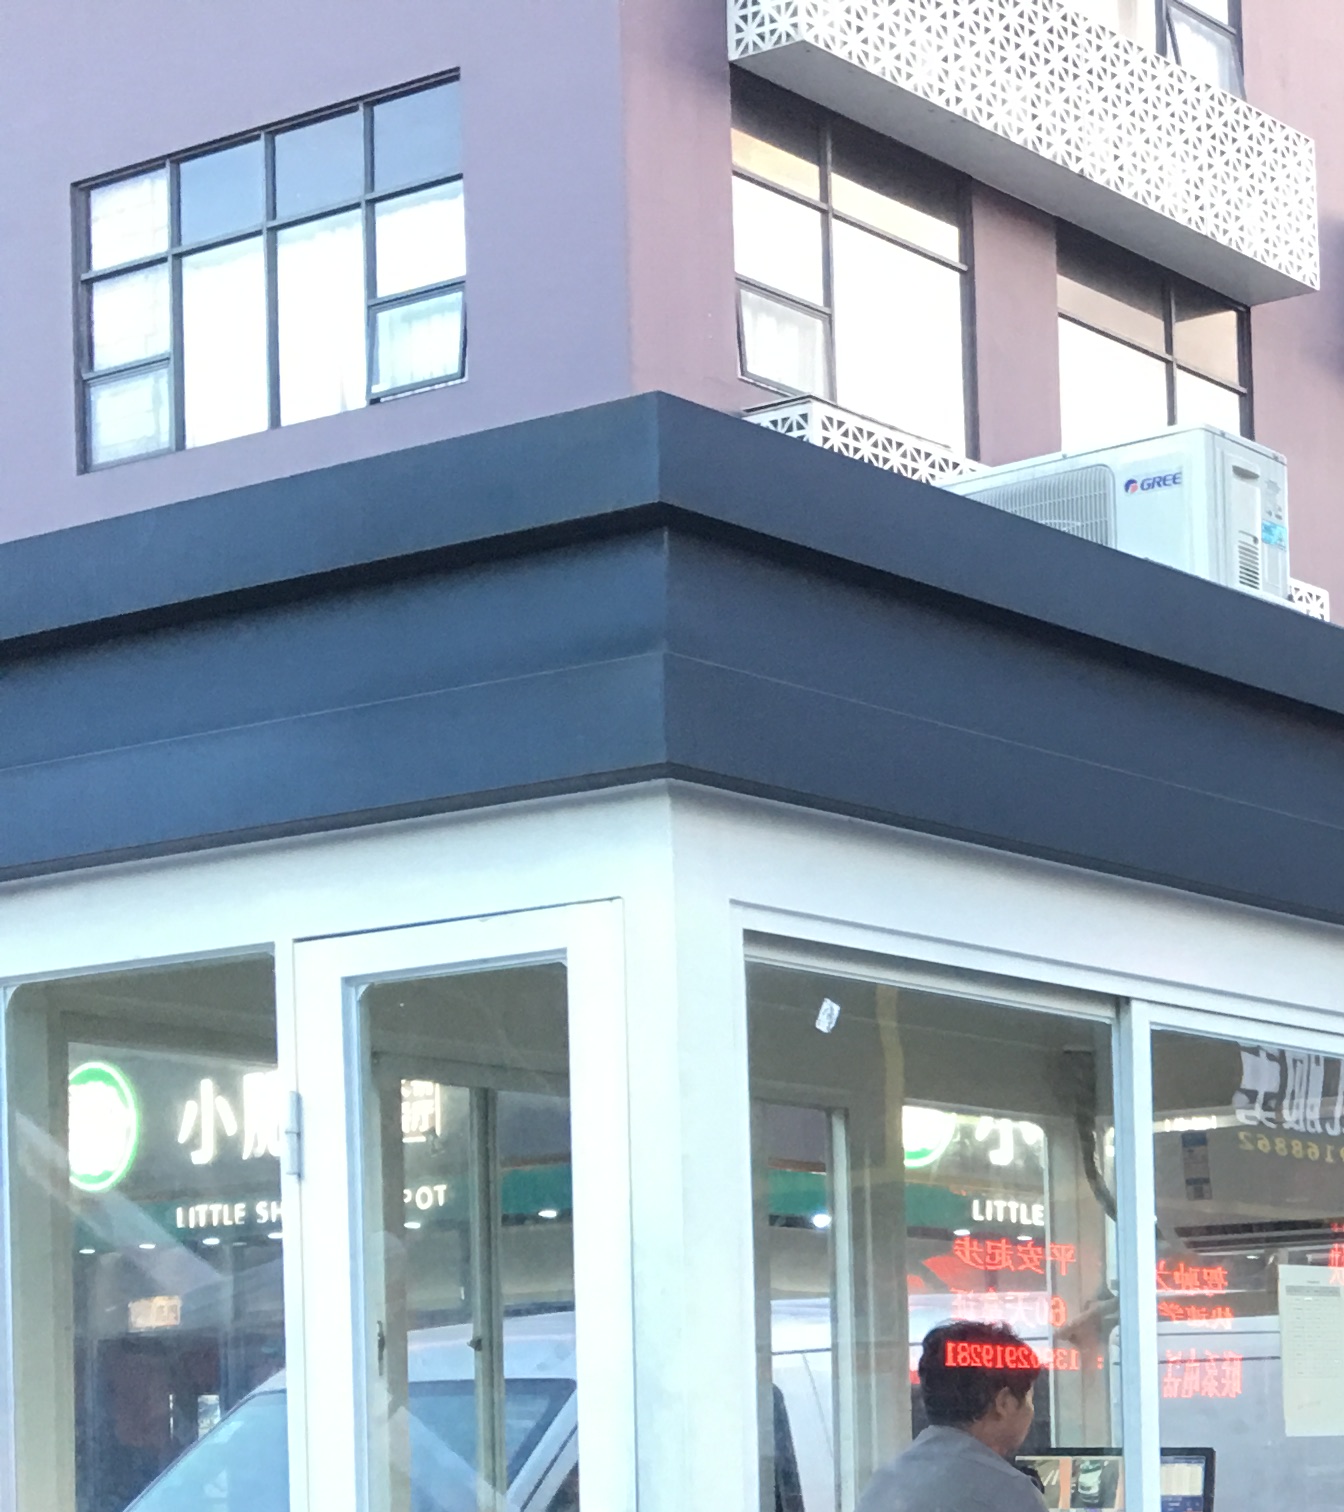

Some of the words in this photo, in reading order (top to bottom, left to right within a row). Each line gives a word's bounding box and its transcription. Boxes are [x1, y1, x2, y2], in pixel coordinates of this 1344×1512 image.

[1139, 470, 1183, 493] GREE
[175, 1202, 247, 1229] LITTLE
[971, 1199, 1046, 1227] LITTLE
